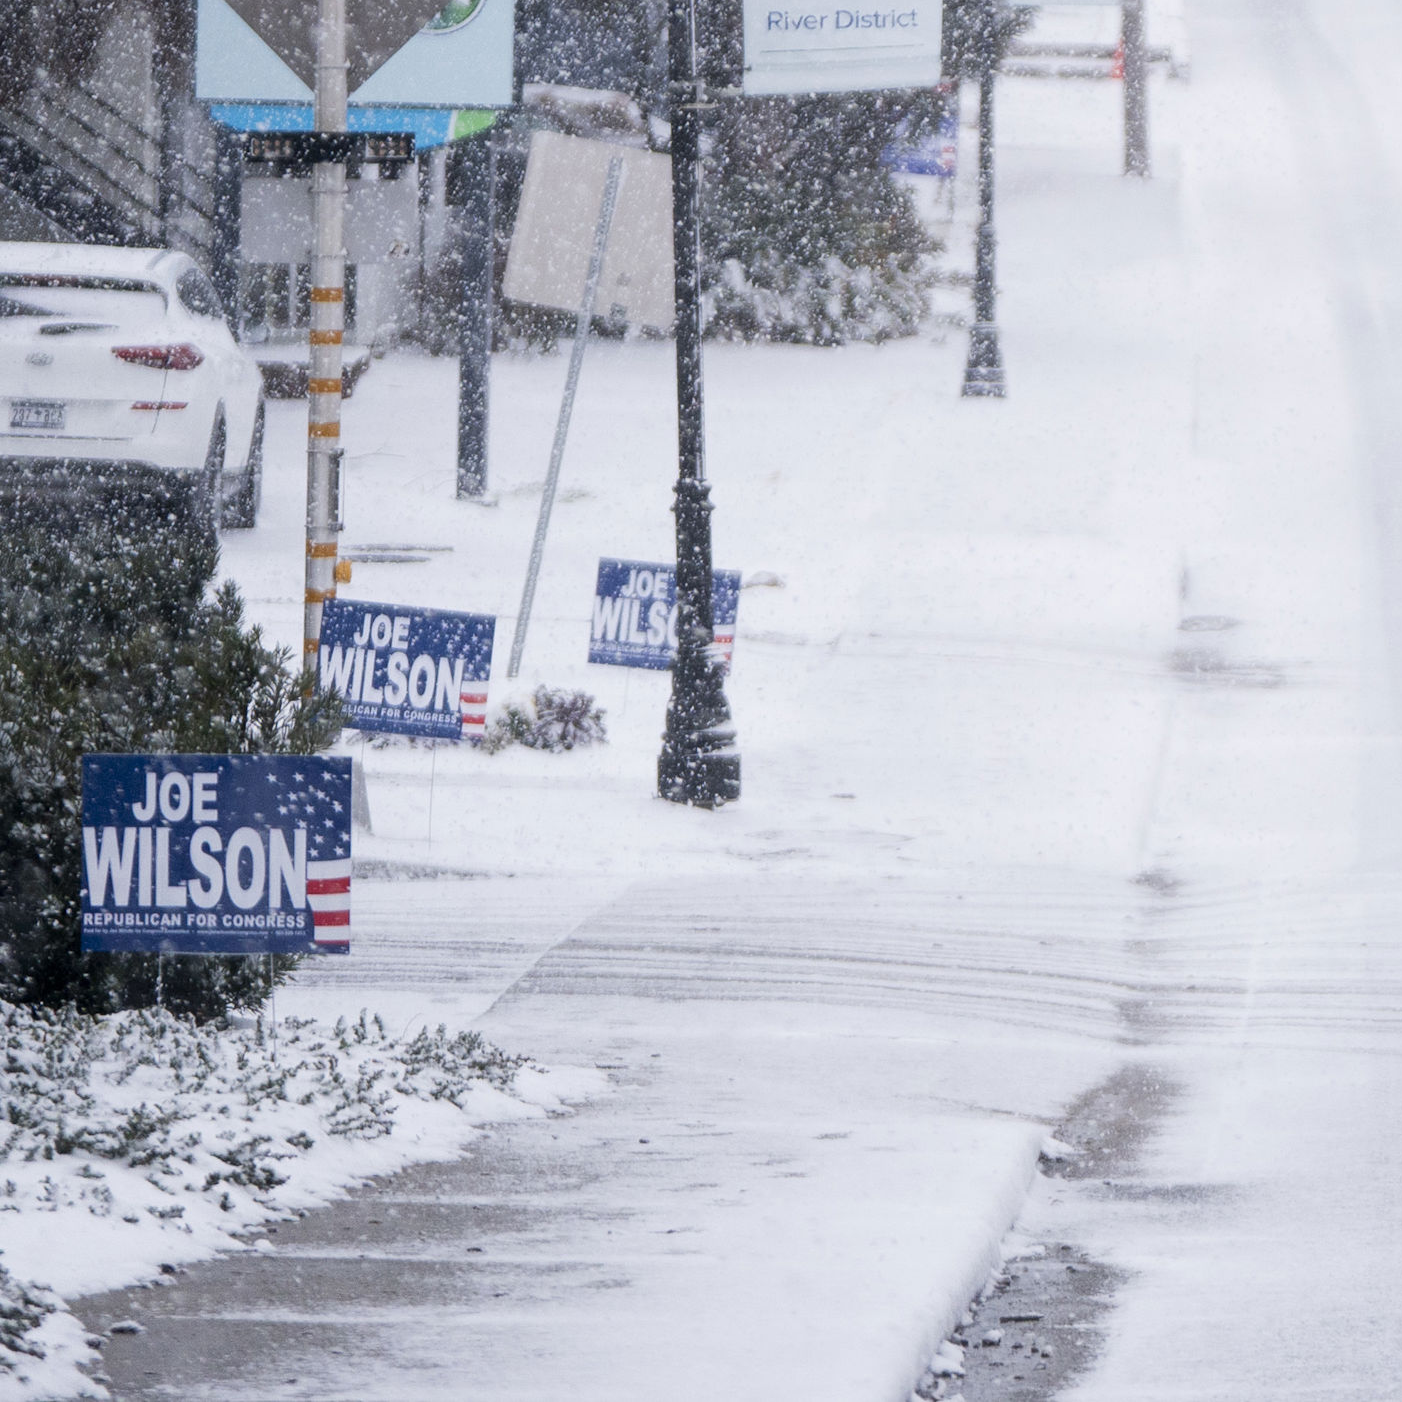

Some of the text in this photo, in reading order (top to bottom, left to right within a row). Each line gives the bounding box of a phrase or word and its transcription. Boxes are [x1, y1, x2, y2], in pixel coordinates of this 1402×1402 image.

[767, 9, 919, 31] River District
[621, 569, 669, 598] JOE
[353, 613, 411, 648] JOE
[593, 595, 679, 648] WILS
[320, 644, 466, 711] WILSON
[341, 704, 377, 716] BLICAN
[381, 707, 403, 717] FOR
[404, 710, 457, 724] CONGRESS
[132, 771, 218, 822] JOE
[83, 826, 307, 909] WILSON
[83, 913, 305, 929] REPUBLICAN FOR CONGRESS
